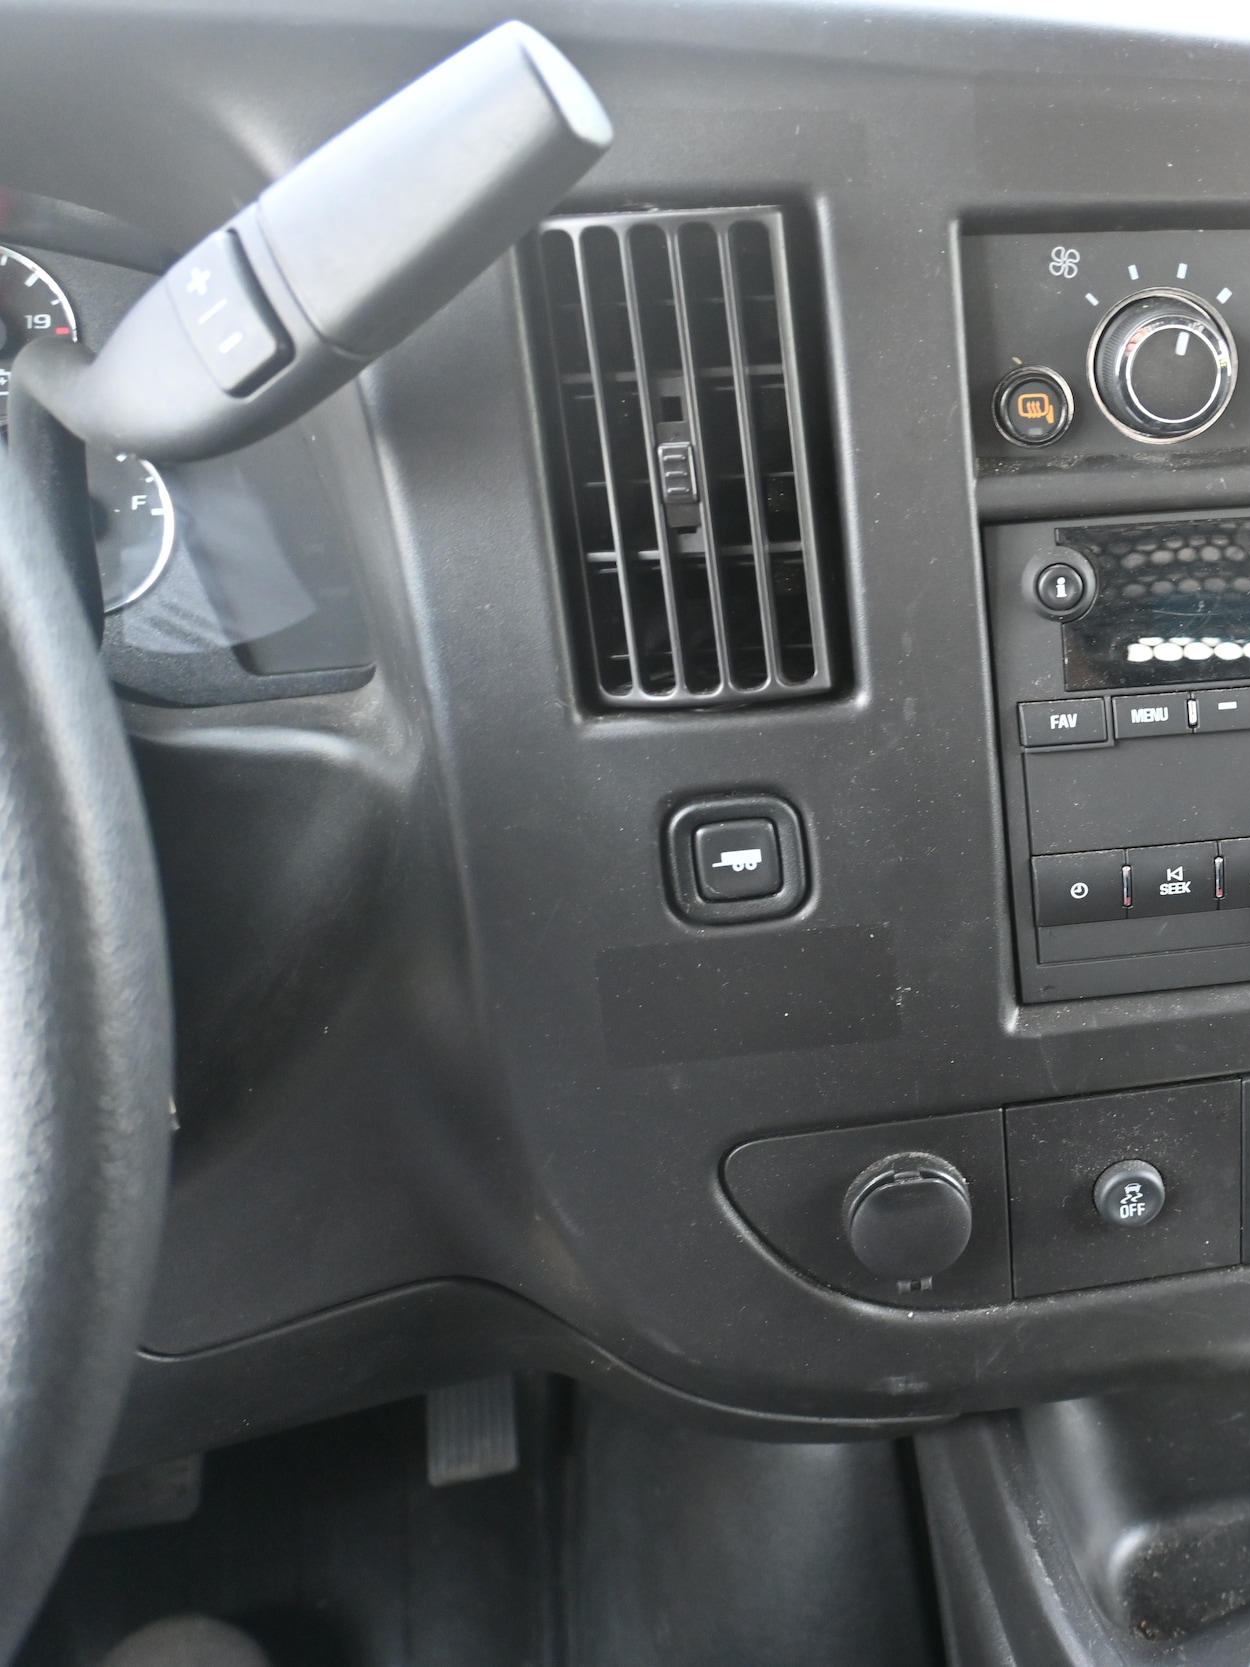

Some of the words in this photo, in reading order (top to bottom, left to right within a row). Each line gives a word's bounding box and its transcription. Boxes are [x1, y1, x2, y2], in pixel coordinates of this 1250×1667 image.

[26, 314, 51, 329] 19
[132, 495, 147, 510] F
[1050, 713, 1077, 729] FAV
[1131, 707, 1168, 723] MENU
[1160, 881, 1191, 895] SEEK
[1120, 1203, 1145, 1218] OFF
